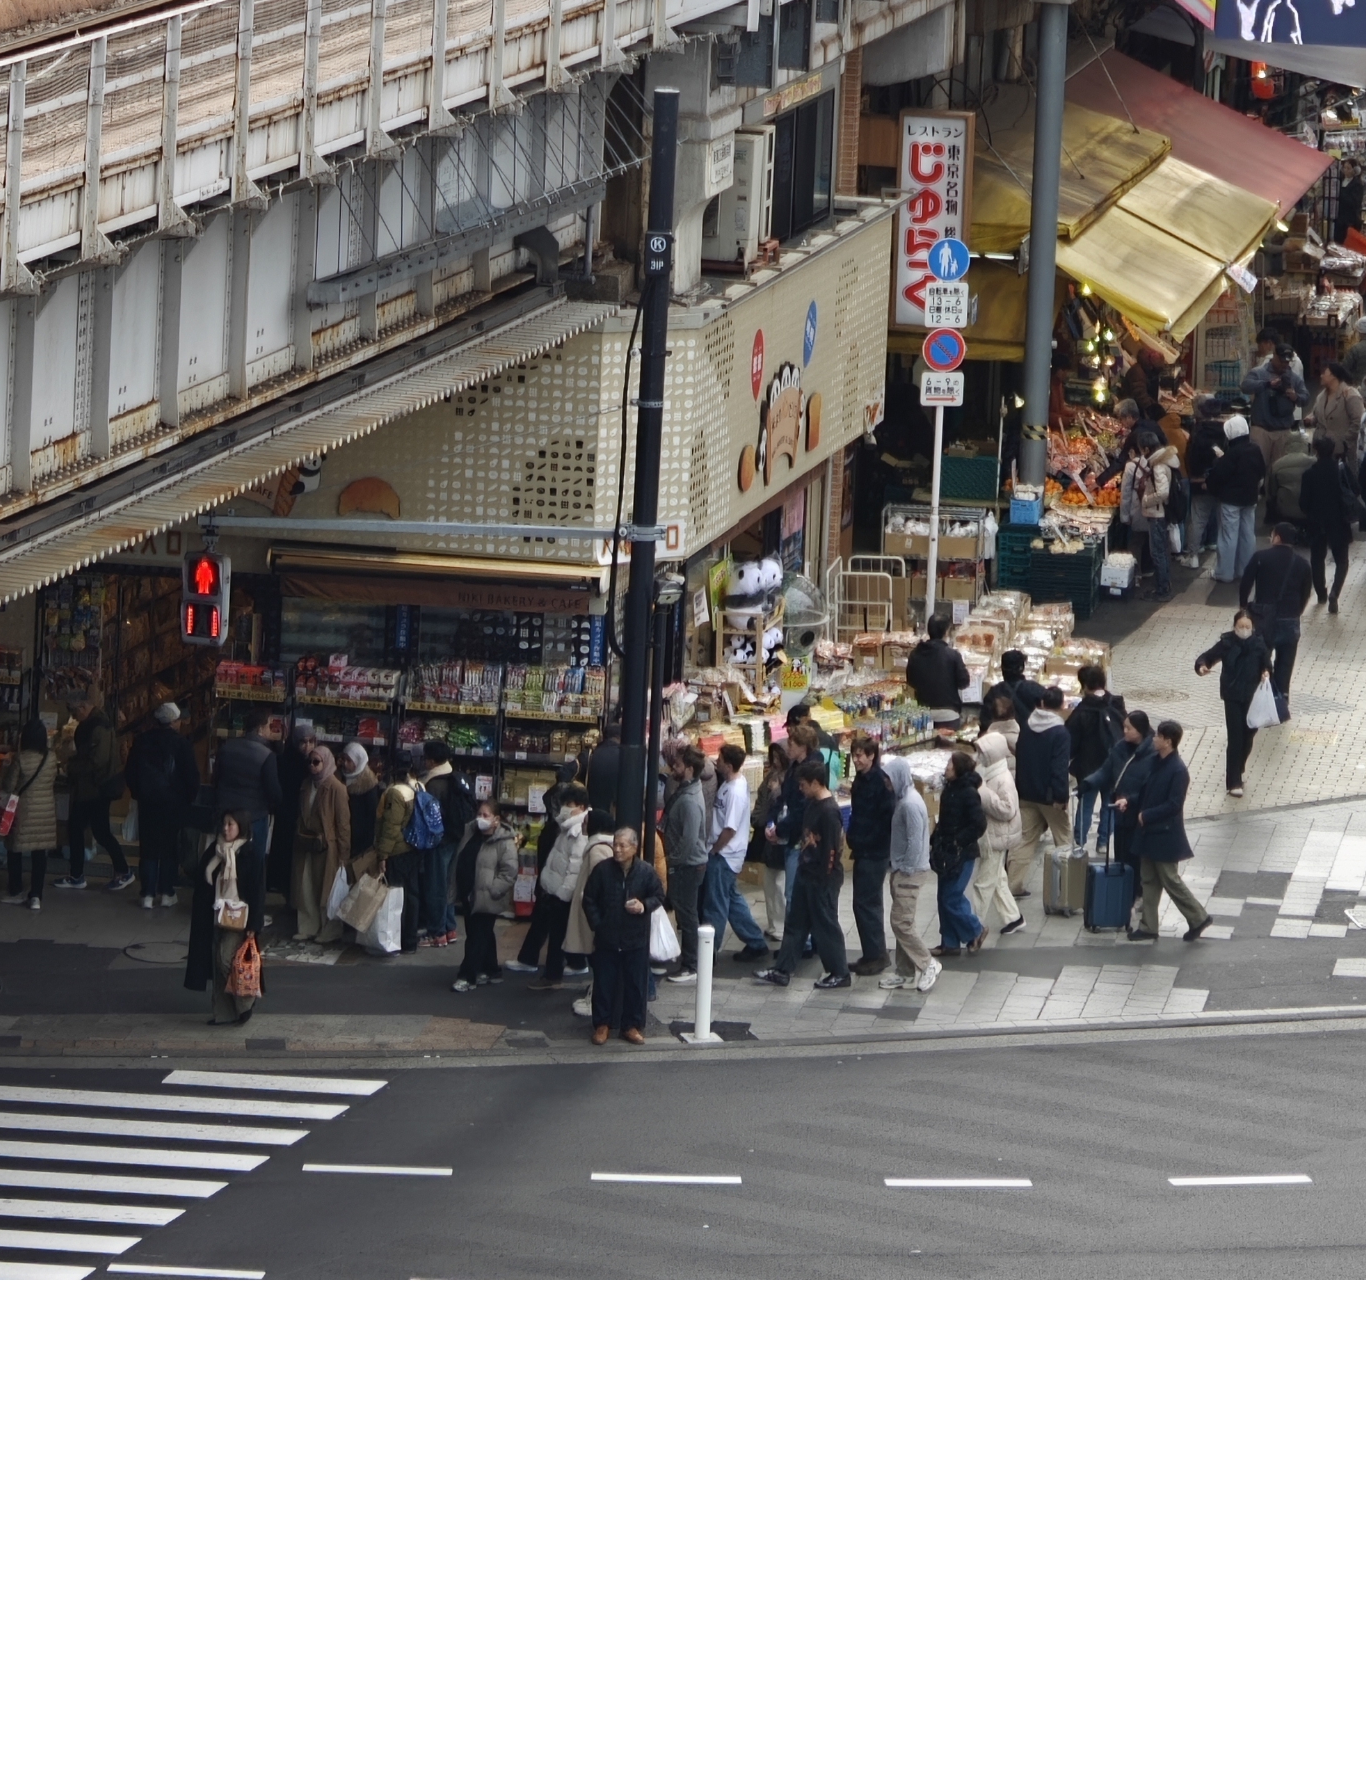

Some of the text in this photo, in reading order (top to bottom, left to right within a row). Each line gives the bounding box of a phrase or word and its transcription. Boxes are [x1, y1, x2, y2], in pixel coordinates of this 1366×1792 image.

[906, 124, 964, 139] レストラン
[946, 145, 961, 217] 東京名物
[901, 141, 945, 312] じゅらく
[929, 287, 964, 297] 自転車を除く
[488, 594, 534, 606] BAKERY
[551, 598, 582, 609] CAFE
